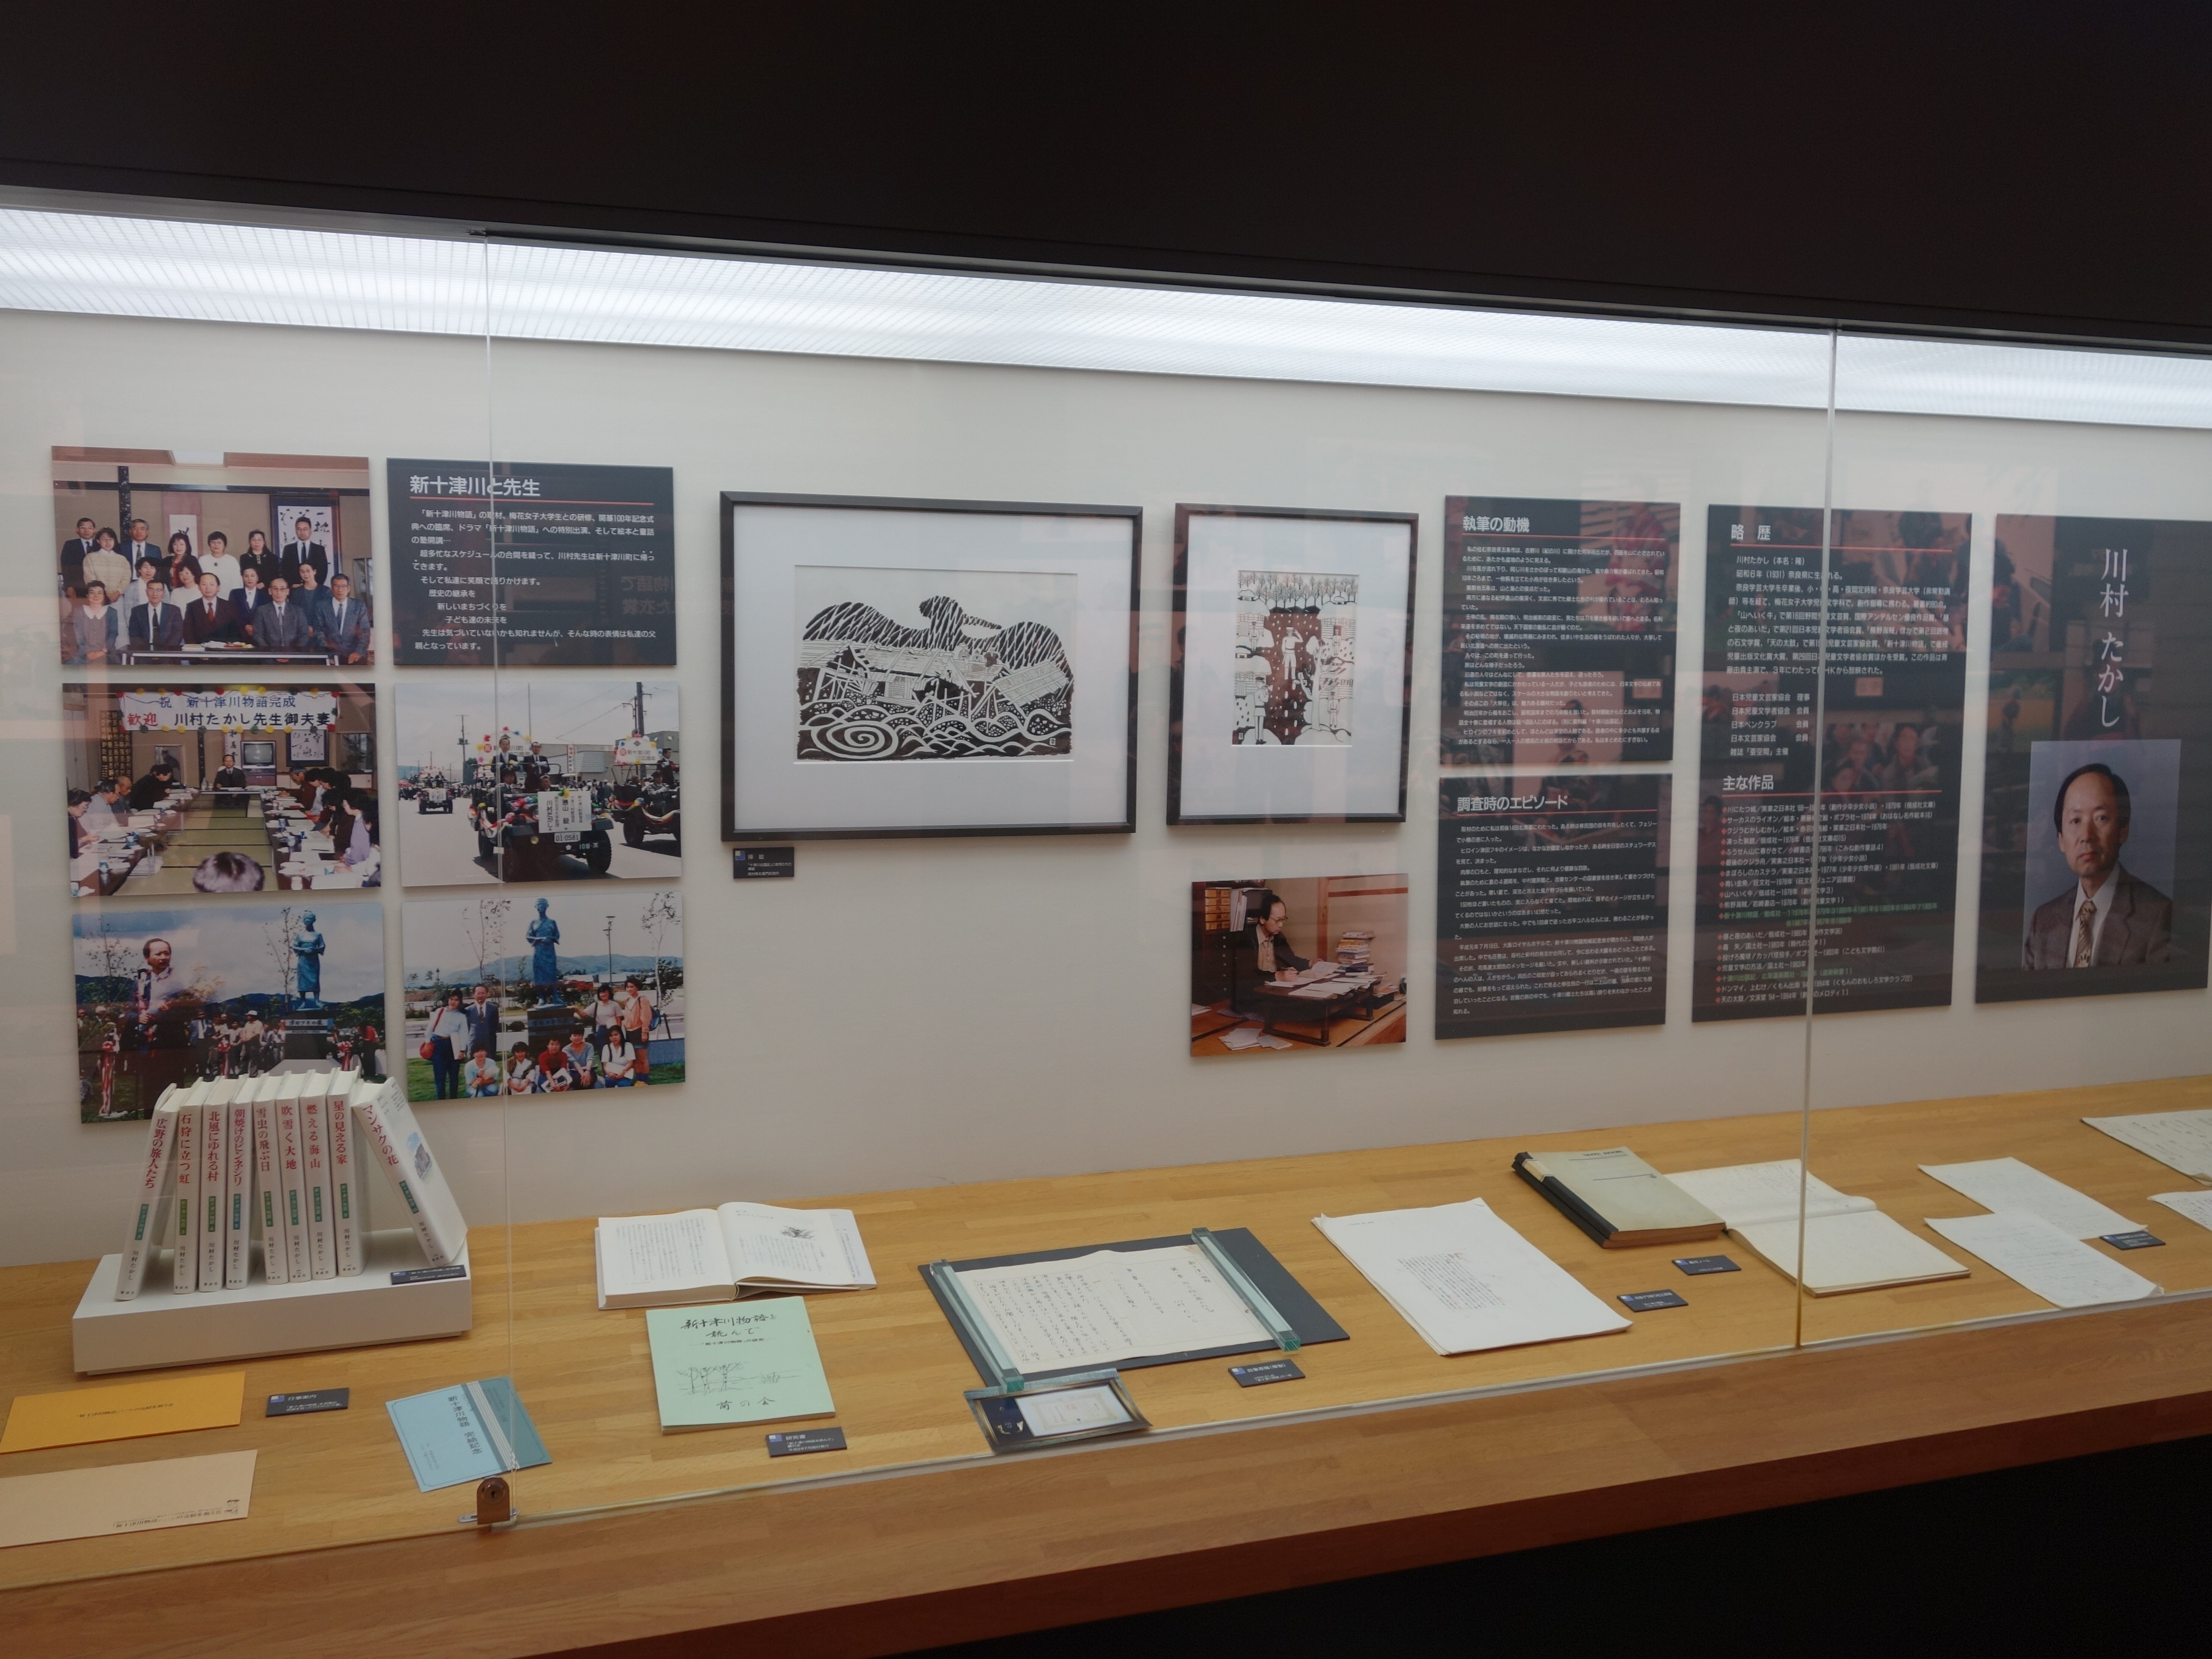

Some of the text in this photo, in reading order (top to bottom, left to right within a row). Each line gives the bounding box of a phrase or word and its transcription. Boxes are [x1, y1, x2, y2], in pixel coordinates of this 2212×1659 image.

[409, 475, 541, 497] 新十津川と先生
[1463, 515, 1530, 532] 執筆の動機
[412, 559, 447, 571] てきます。
[420, 576, 540, 586] そして私達に笑顔で語りかけます。
[1736, 569, 1843, 580] 昭和6年（1931）奈良県に生れる。
[444, 615, 508, 624] 子ども達の未来を
[2097, 548, 2130, 728] 川村 たかし
[415, 642, 481, 650] 親となっています。
[127, 712, 331, 727] 歓迎 川村たかし先生御夫妻
[158, 695, 296, 708] 祝 新十津川物語完成
[1457, 794, 1568, 811] 調査時のエピソード
[1723, 775, 1774, 791] 主な作品
[178, 1113, 192, 1184] 石狩に立つ虹
[207, 1111, 221, 1182] 北風にゆれる村
[233, 1108, 246, 1187] 朝焼けのピンネシリ
[255, 1107, 270, 1172] 雪虫の飛ぶ日
[281, 1105, 297, 1170] 吹雪く大地
[306, 1104, 321, 1169] 燃える海山
[333, 1100, 348, 1165] 星の見える家
[362, 1104, 400, 1166] マンサクの花
[145, 1118, 168, 1189] 広野の旅人たち
[447, 1395, 483, 1455] 新十津川物語 完結記念
